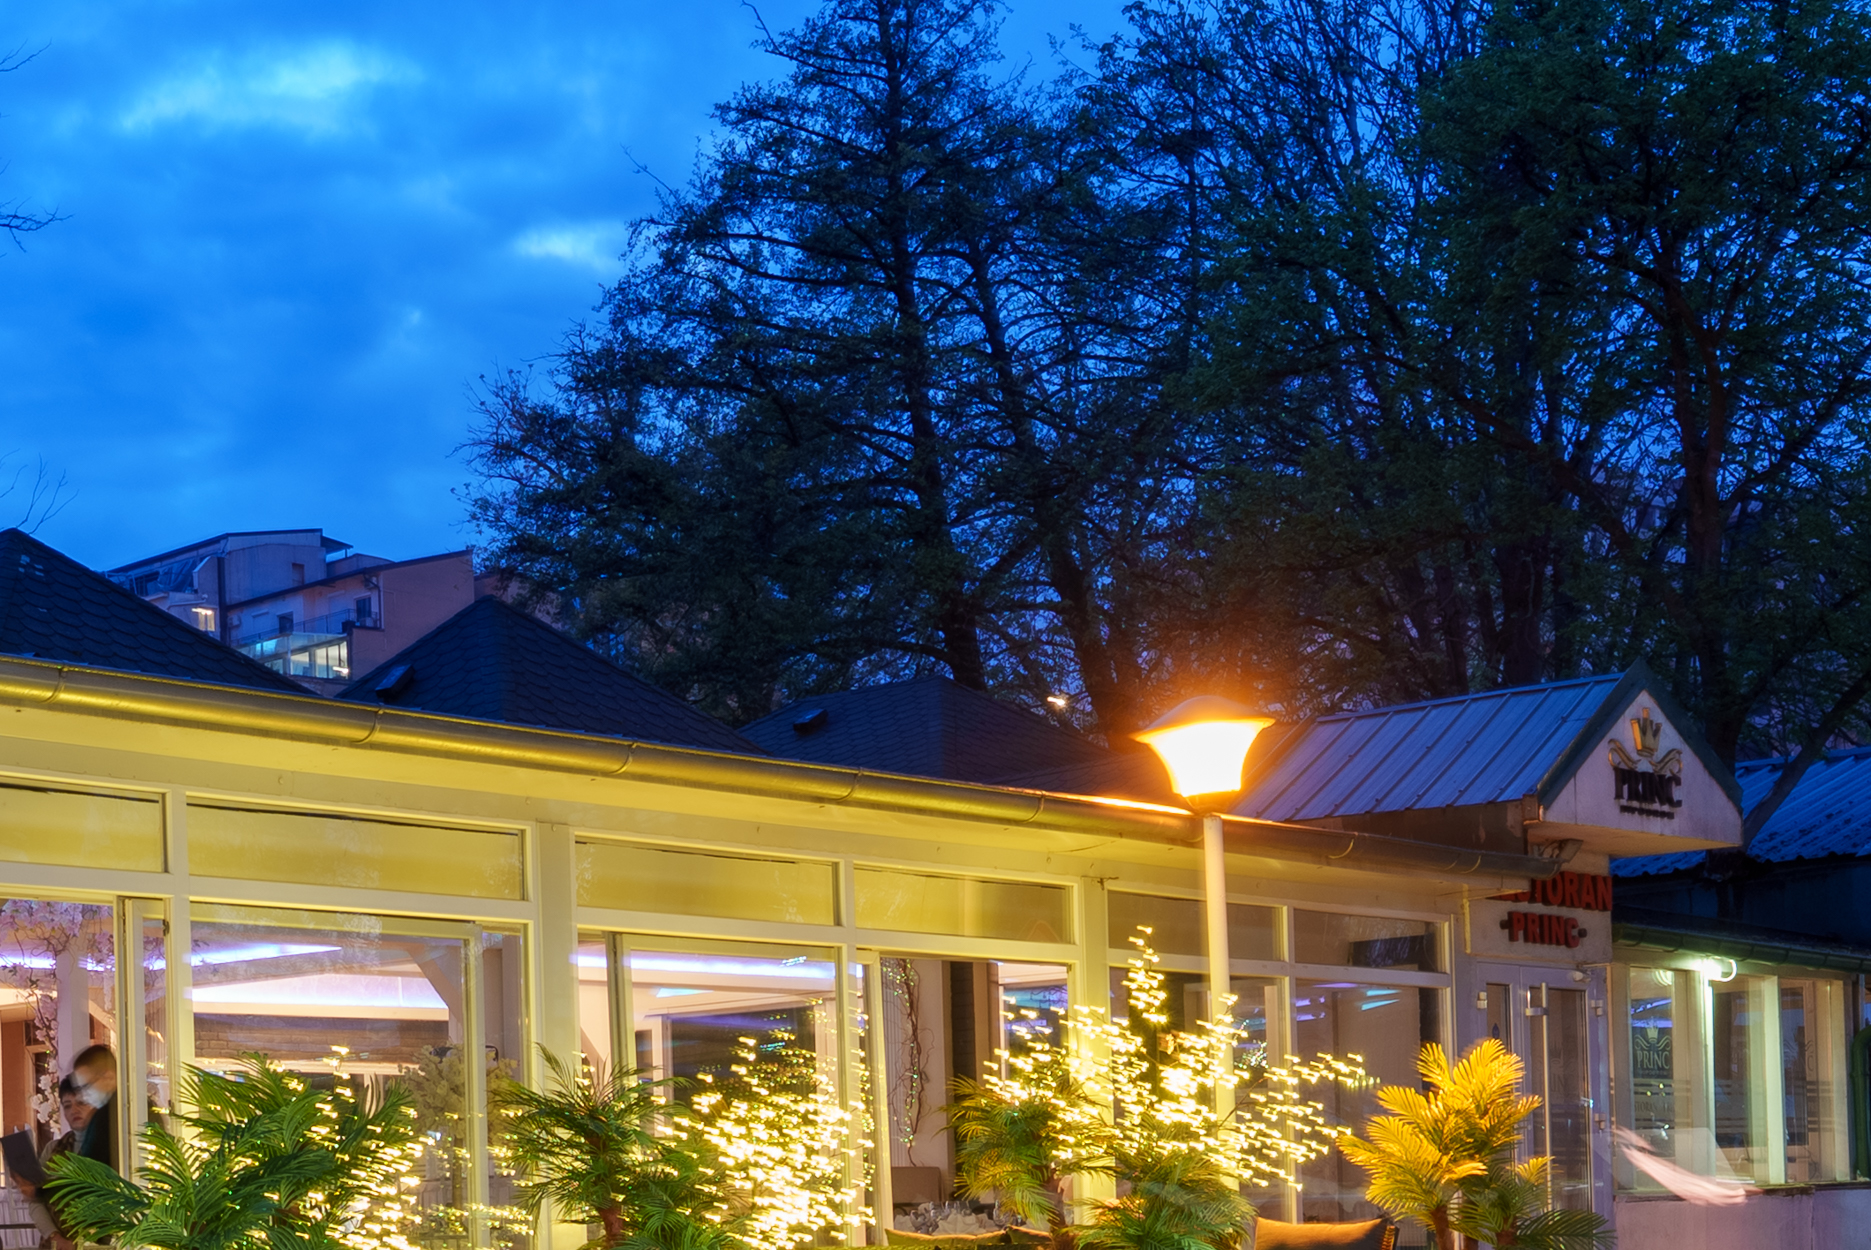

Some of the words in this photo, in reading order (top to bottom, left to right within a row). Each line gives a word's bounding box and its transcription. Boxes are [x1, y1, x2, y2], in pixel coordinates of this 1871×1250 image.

[1614, 767, 1683, 808] PRINC
[1486, 870, 1612, 911] TORAN
[1508, 910, 1580, 948] PRINC
[1636, 1050, 1670, 1069] PRINC
